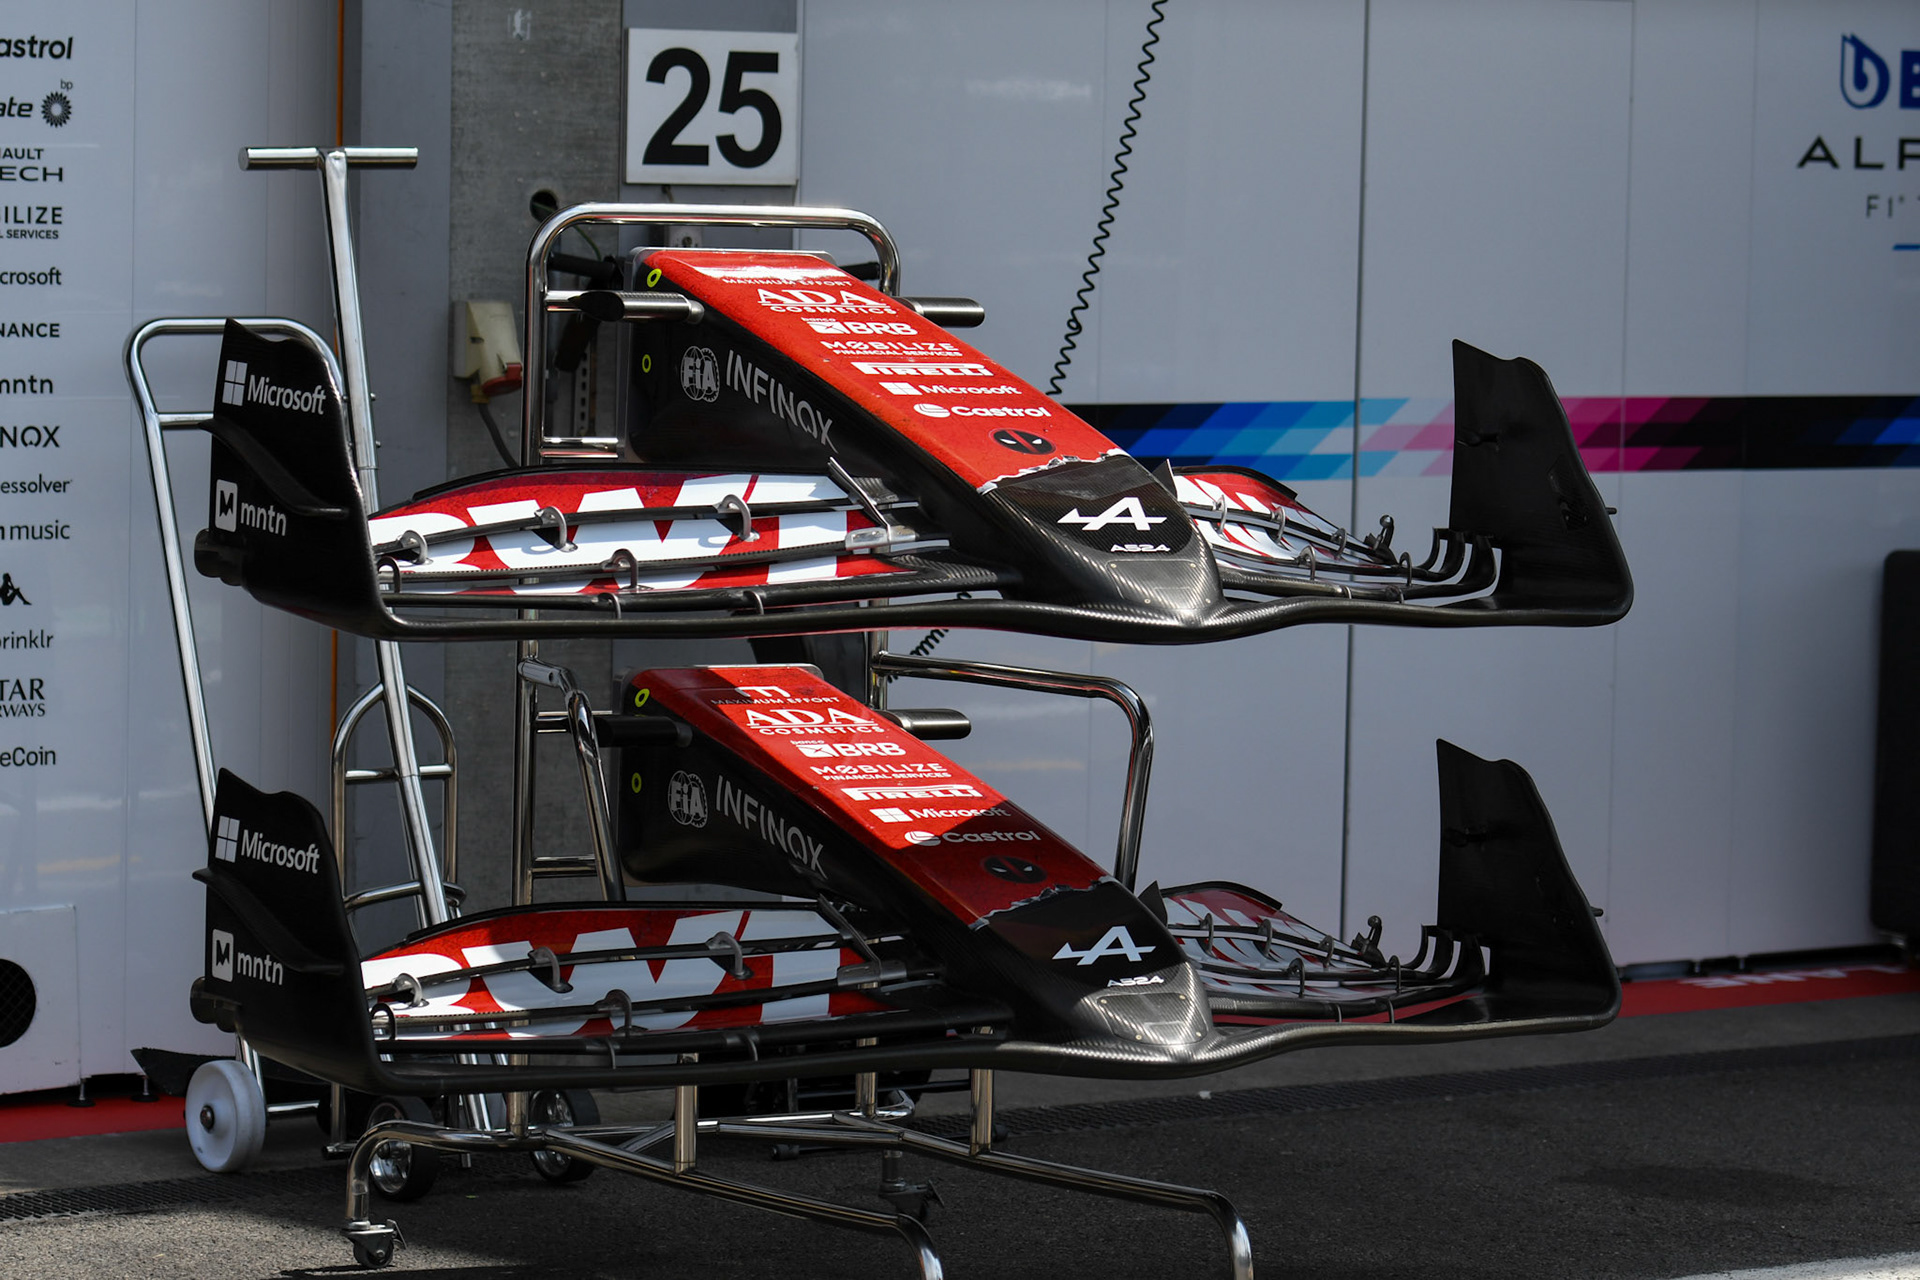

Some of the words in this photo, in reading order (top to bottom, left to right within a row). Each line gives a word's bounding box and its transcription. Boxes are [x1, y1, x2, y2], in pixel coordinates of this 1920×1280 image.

[60, 79, 73, 91] bp
[642, 47, 782, 169] 25
[6, 229, 59, 239] SERVICES
[0, 266, 62, 286] crosoft
[757, 288, 888, 306] ADA
[769, 305, 898, 315] COSMETICS
[844, 321, 918, 336] BRB
[850, 361, 995, 377] PIRELLI
[247, 374, 327, 415] Microsoft
[917, 384, 1023, 395] Microsoft
[726, 349, 839, 455] INFINOX
[951, 405, 1052, 418] Castrol
[1, 473, 70, 494] essolver
[240, 502, 287, 537] mntn
[10, 519, 70, 541] music
[0, 629, 54, 649] rinklr
[745, 707, 876, 726] ADA
[758, 726, 886, 736] COSMETICS
[0, 745, 56, 767] eCoin
[832, 742, 907, 757] BRB
[821, 773, 892, 781] FINANCIAL
[892, 771, 953, 780] SERVICES
[840, 783, 984, 801] PIRELLI
[909, 806, 1012, 819] Microsoft
[716, 774, 829, 880] INFINOX
[938, 830, 1042, 843] Castrol
[240, 829, 320, 875] Microsoft
[236, 951, 284, 986] mntn
